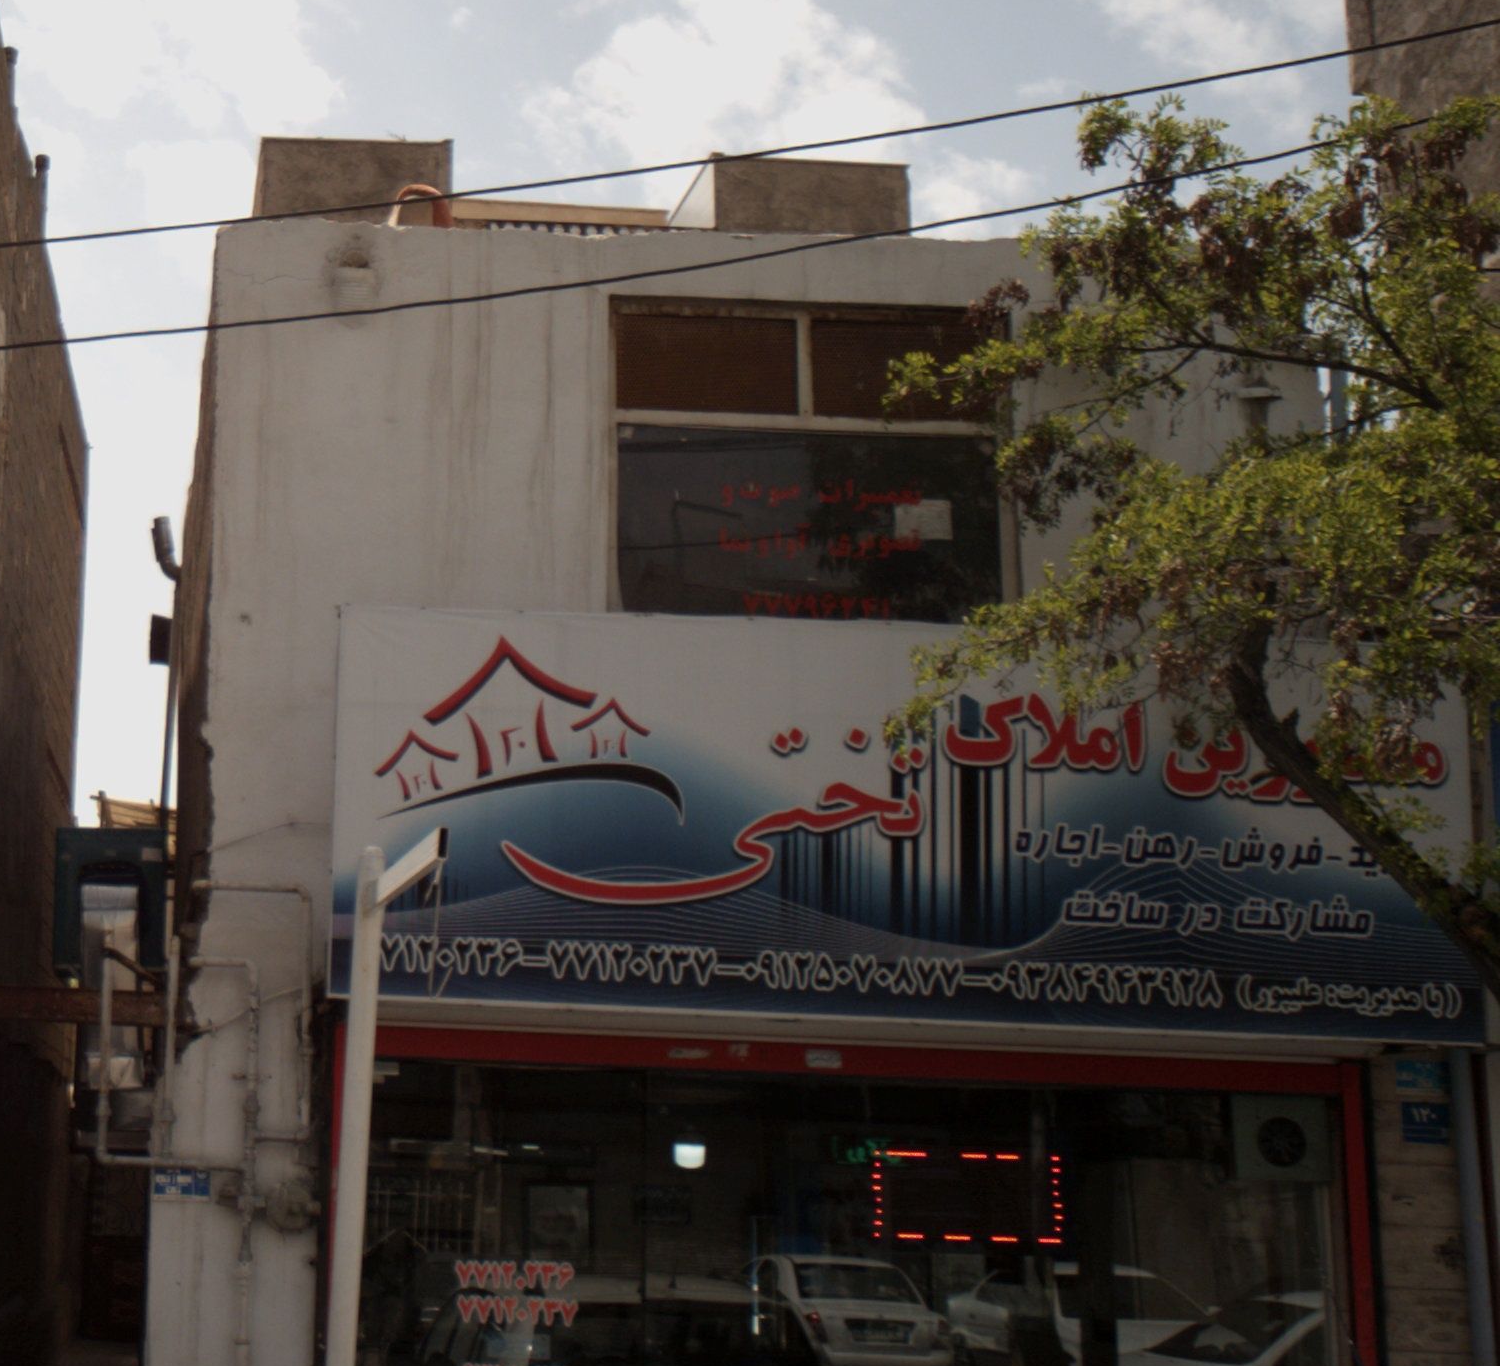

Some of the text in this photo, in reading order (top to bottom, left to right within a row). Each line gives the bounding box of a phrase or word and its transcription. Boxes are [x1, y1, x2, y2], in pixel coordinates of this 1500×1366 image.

[944, 693, 1147, 773] املاک
[500, 725, 930, 907] تختی
[1060, 888, 1377, 940] مشارکت در ساخت
[454, 1258, 576, 1291] ۷۷۱۲۰۲۳۶
[457, 1294, 580, 1328] ۷۷۱۲۰۲۳۷
